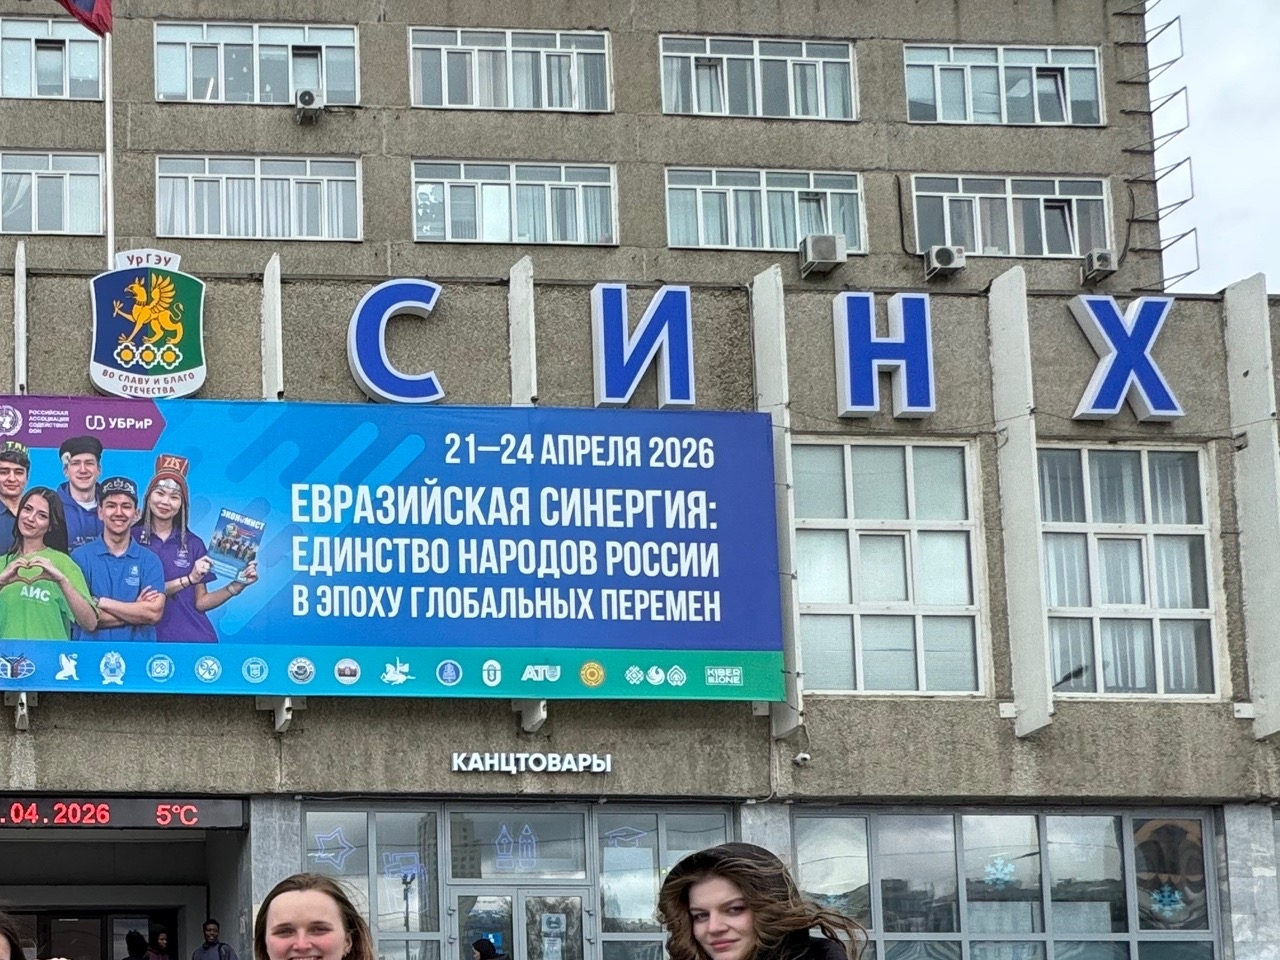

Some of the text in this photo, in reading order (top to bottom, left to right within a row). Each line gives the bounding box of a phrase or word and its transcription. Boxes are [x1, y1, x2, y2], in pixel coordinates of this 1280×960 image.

[126, 254, 172, 266] УрГЭУ
[102, 369, 115, 379] ВО
[118, 374, 150, 385] СЛАВУ
[163, 372, 195, 384] БЛАГО
[122, 386, 176, 395] ОТЕЧЕСТВА
[108, 417, 153, 429] УБРиР
[540, 433, 642, 468] АПРЕЛЯ
[648, 436, 715, 469] 2026
[290, 477, 719, 530] ЕВРАЗИЙСКАЯ СИНЕРГИЯ:
[291, 535, 720, 579] ЕДИНСТВО НАРОДОВ РОССИИ
[20, 585, 51, 602] АИС
[292, 585, 721, 623] В ЭПОХУ ГЛОБАЛЬНЫХ ПЕРЕМЕН
[451, 752, 612, 775] КАНЦТОВАРЫ
[156, 804, 199, 826] 5°C
